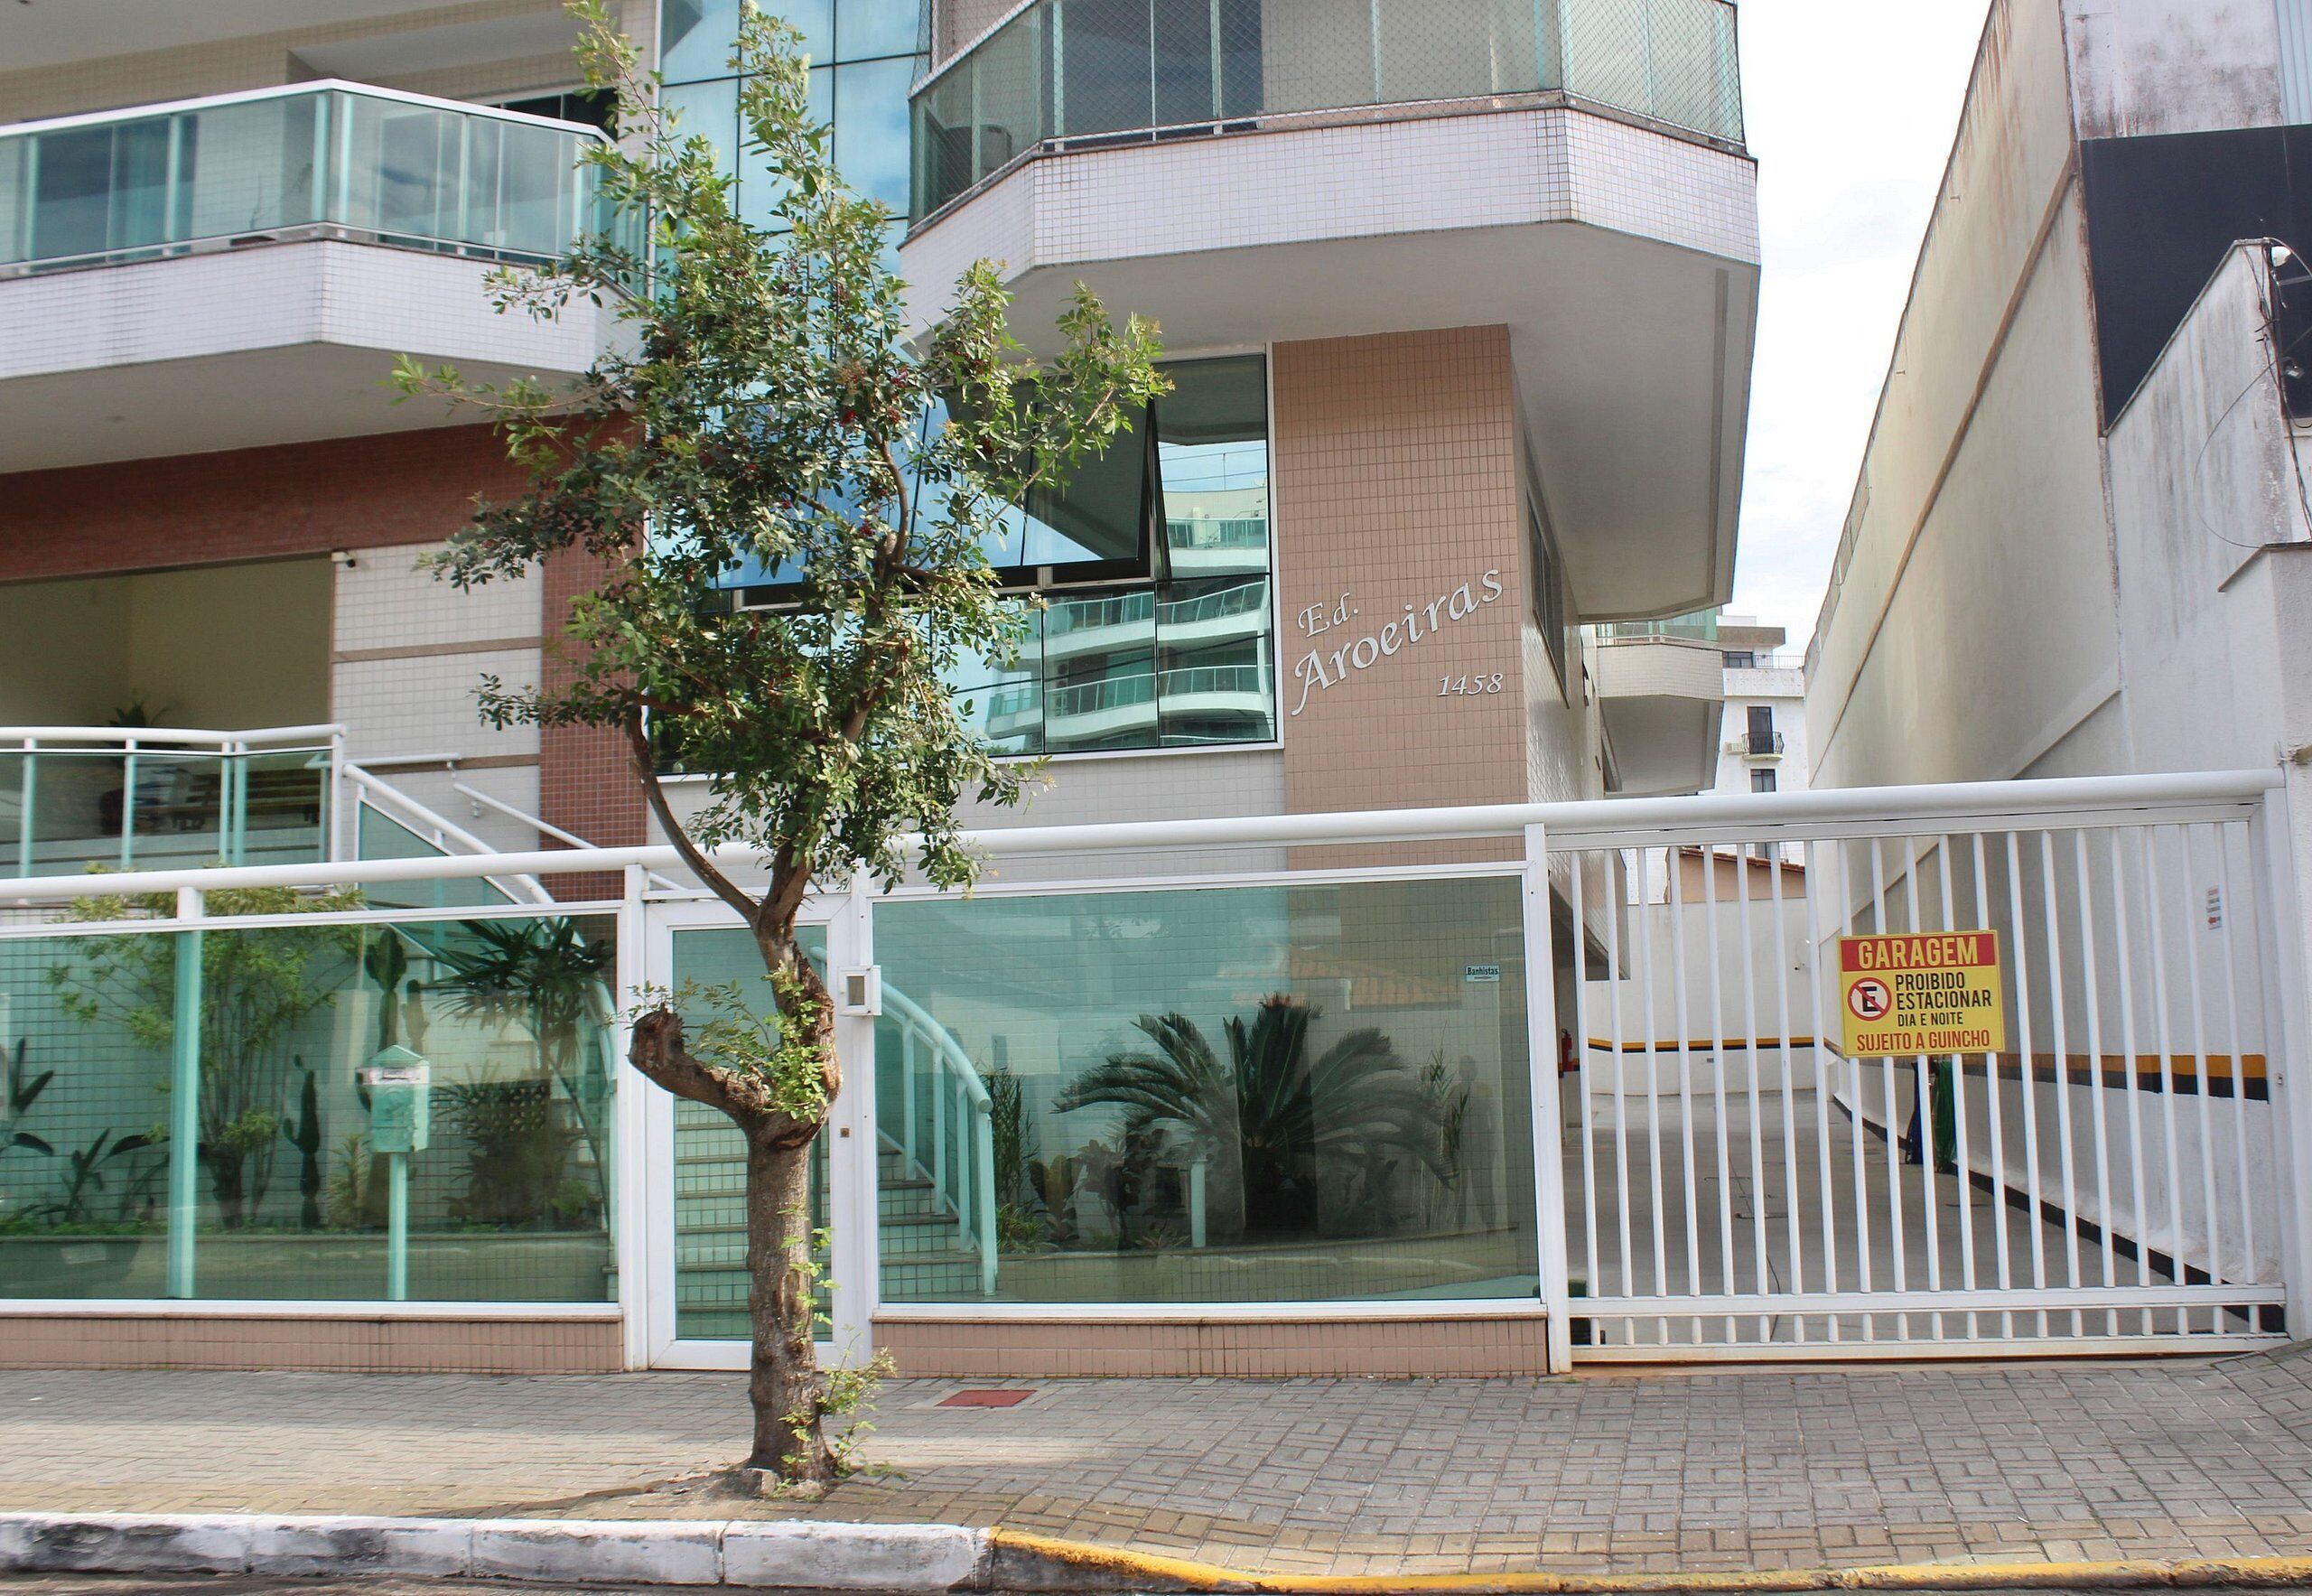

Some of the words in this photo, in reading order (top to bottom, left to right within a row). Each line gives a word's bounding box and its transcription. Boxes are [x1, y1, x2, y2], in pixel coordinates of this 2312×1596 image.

[1298, 592, 1358, 638] Ed.
[1291, 569, 1503, 716] Aroeiras
[1437, 673, 1504, 696] 1458
[1858, 937, 1978, 969] GARAGEM
[1896, 972, 1965, 991] PROIBIDO
[1897, 990, 1992, 1010] ESTACIONAR
[1897, 1013, 1916, 1027] DIA
[1920, 1013, 1927, 1026] E
[1931, 1012, 1963, 1026] NOITE
[1857, 1032, 1912, 1051] SUJEITO
[1916, 1032, 1925, 1050] A
[1928, 1030, 1990, 1050] GUINCHO
